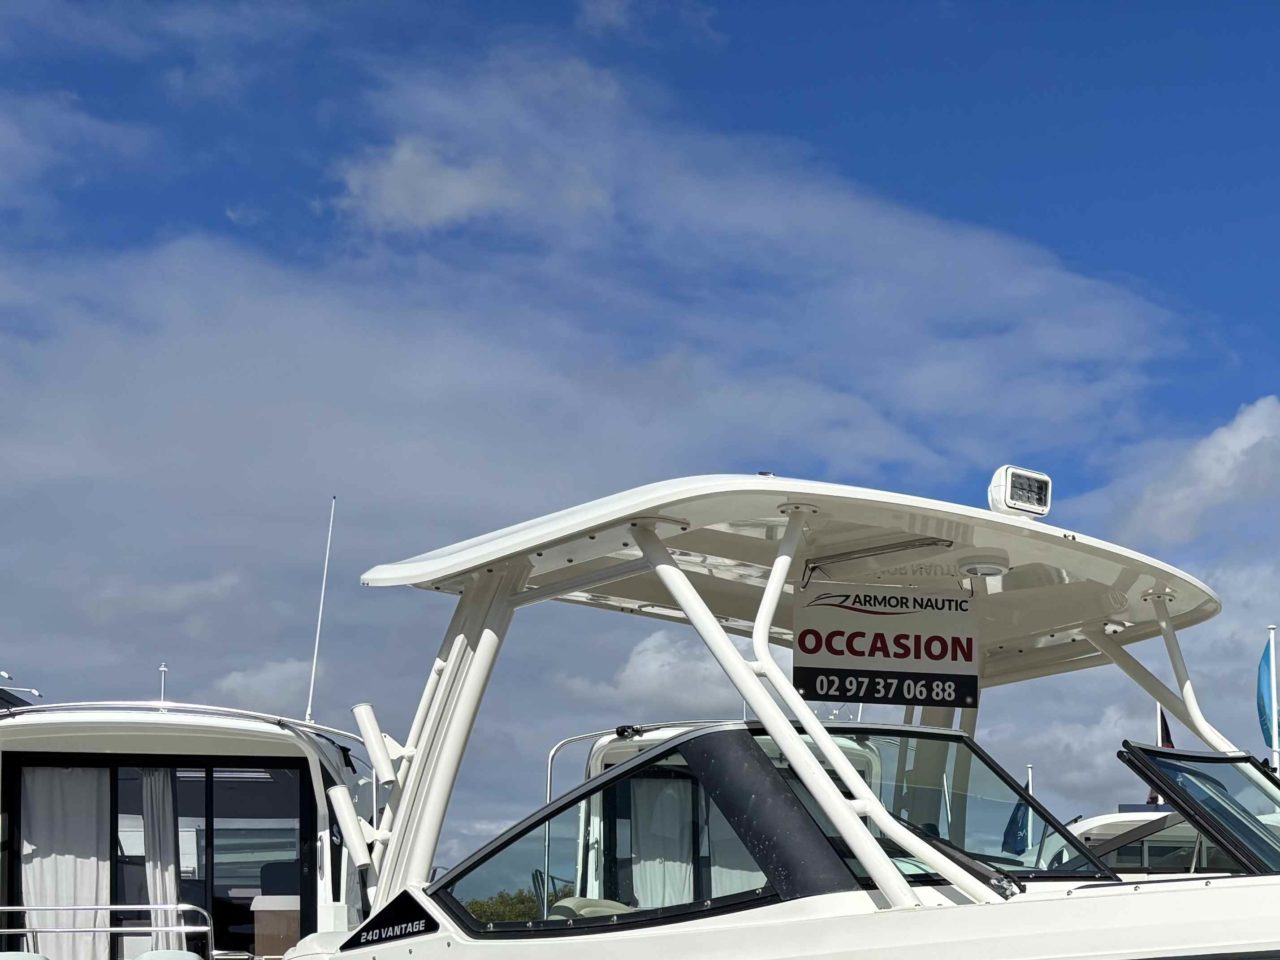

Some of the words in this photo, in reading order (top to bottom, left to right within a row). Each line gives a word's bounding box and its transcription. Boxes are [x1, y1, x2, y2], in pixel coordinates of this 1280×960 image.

[851, 593, 910, 609] ARMOR
[912, 596, 969, 612] NAUTIC
[797, 628, 974, 662] OCCASION
[815, 675, 840, 696] 02
[845, 676, 870, 697] 97
[874, 678, 898, 698] 37
[902, 679, 927, 700] 06
[931, 680, 956, 701] 88
[360, 929, 380, 943] 240
[381, 919, 426, 939] VANTAGE
